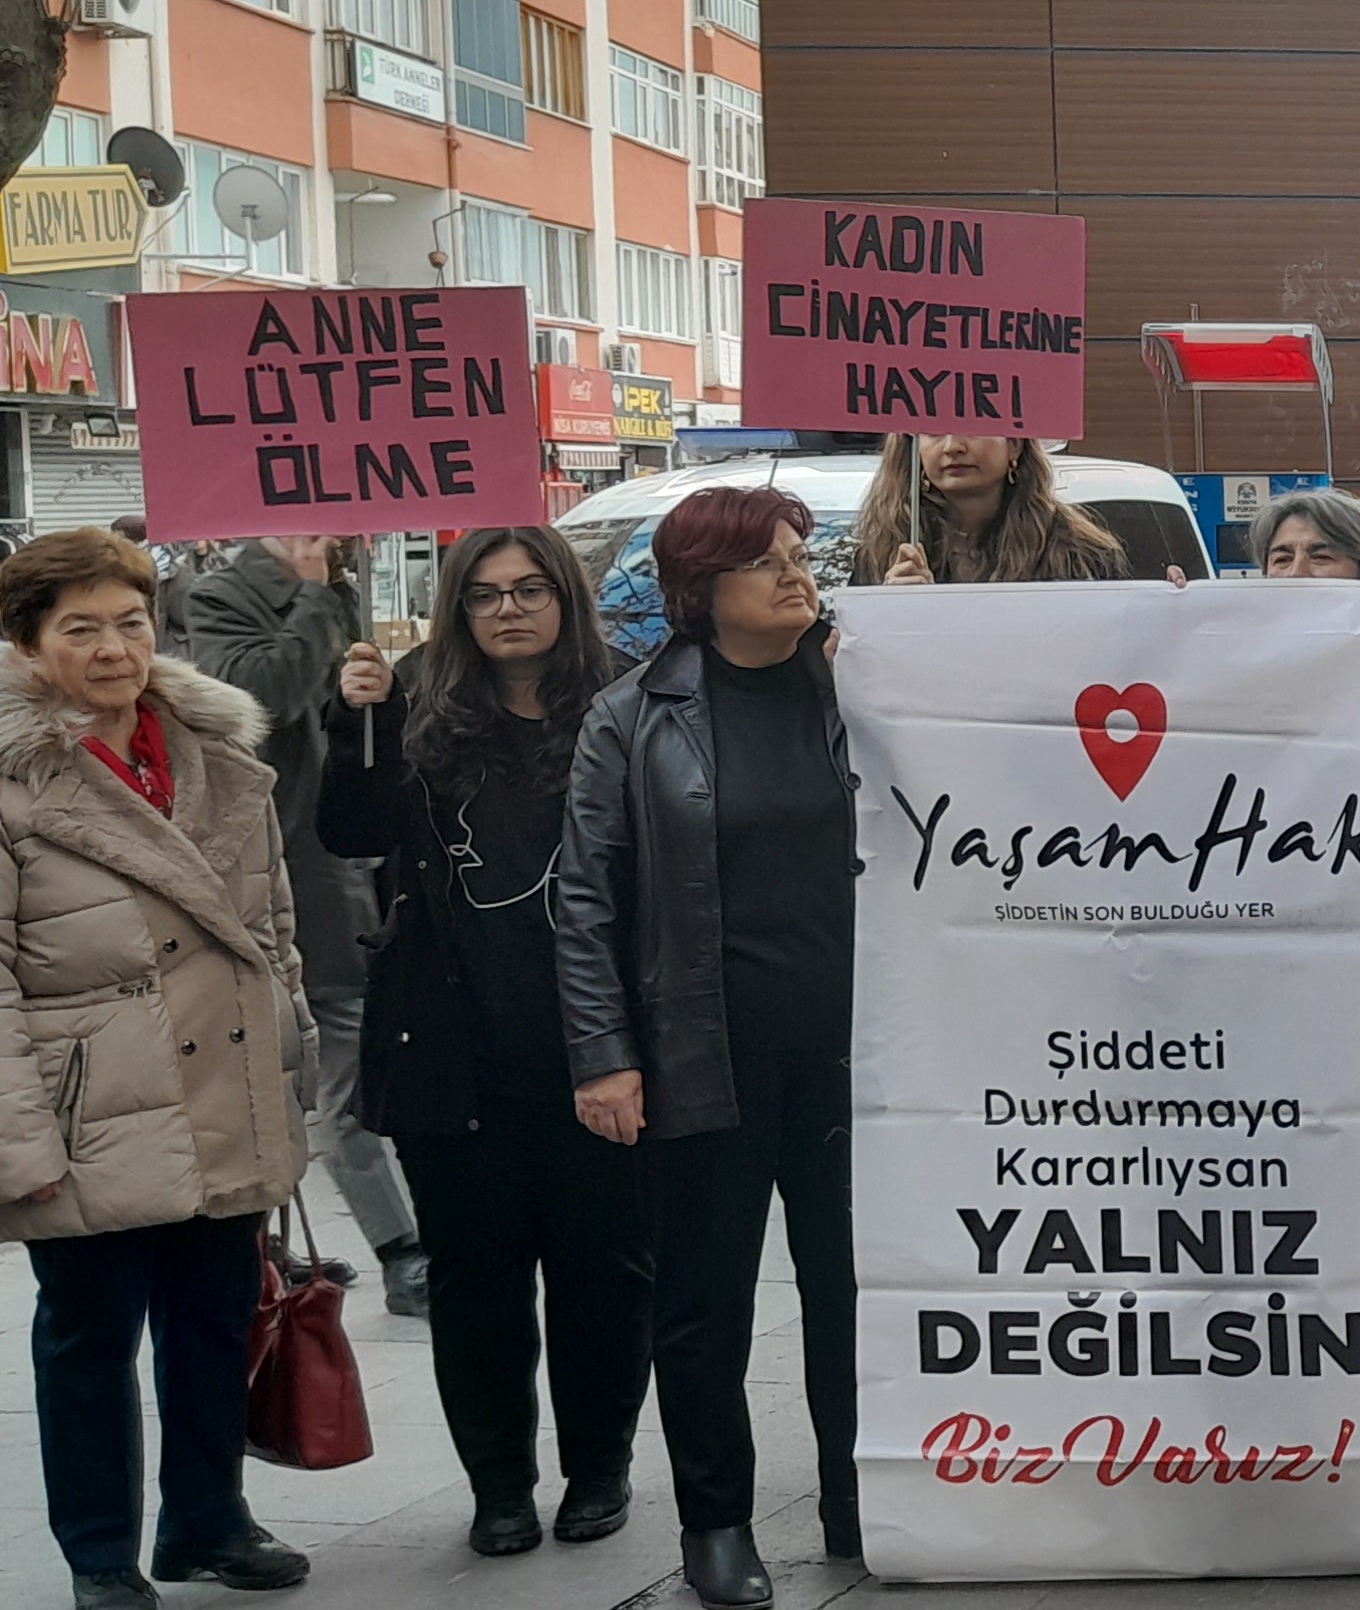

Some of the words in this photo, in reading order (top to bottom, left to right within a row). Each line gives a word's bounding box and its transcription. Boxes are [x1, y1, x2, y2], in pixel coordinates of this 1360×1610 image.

[7, 189, 87, 248] FARMA
[87, 187, 132, 243] TUR
[824, 210, 984, 277] KADIN
[248, 292, 446, 357] ANNE
[767, 279, 1082, 356] CİNAYETLERİNE
[184, 358, 507, 427] LÜTFEN
[846, 362, 1024, 428] HAYIR!
[256, 433, 476, 506] ÖLME
[994, 901, 1079, 923] ŞİDDETİN
[1083, 905, 1124, 922] SON
[1130, 899, 1229, 921] BULDUĞU
[1235, 902, 1275, 919] YER
[1047, 1028, 1225, 1080] Şiddeti
[984, 1088, 1301, 1138] Durdurmaya
[996, 1145, 1289, 1197] Kararlıysan
[957, 1207, 1320, 1276] YALNIZ
